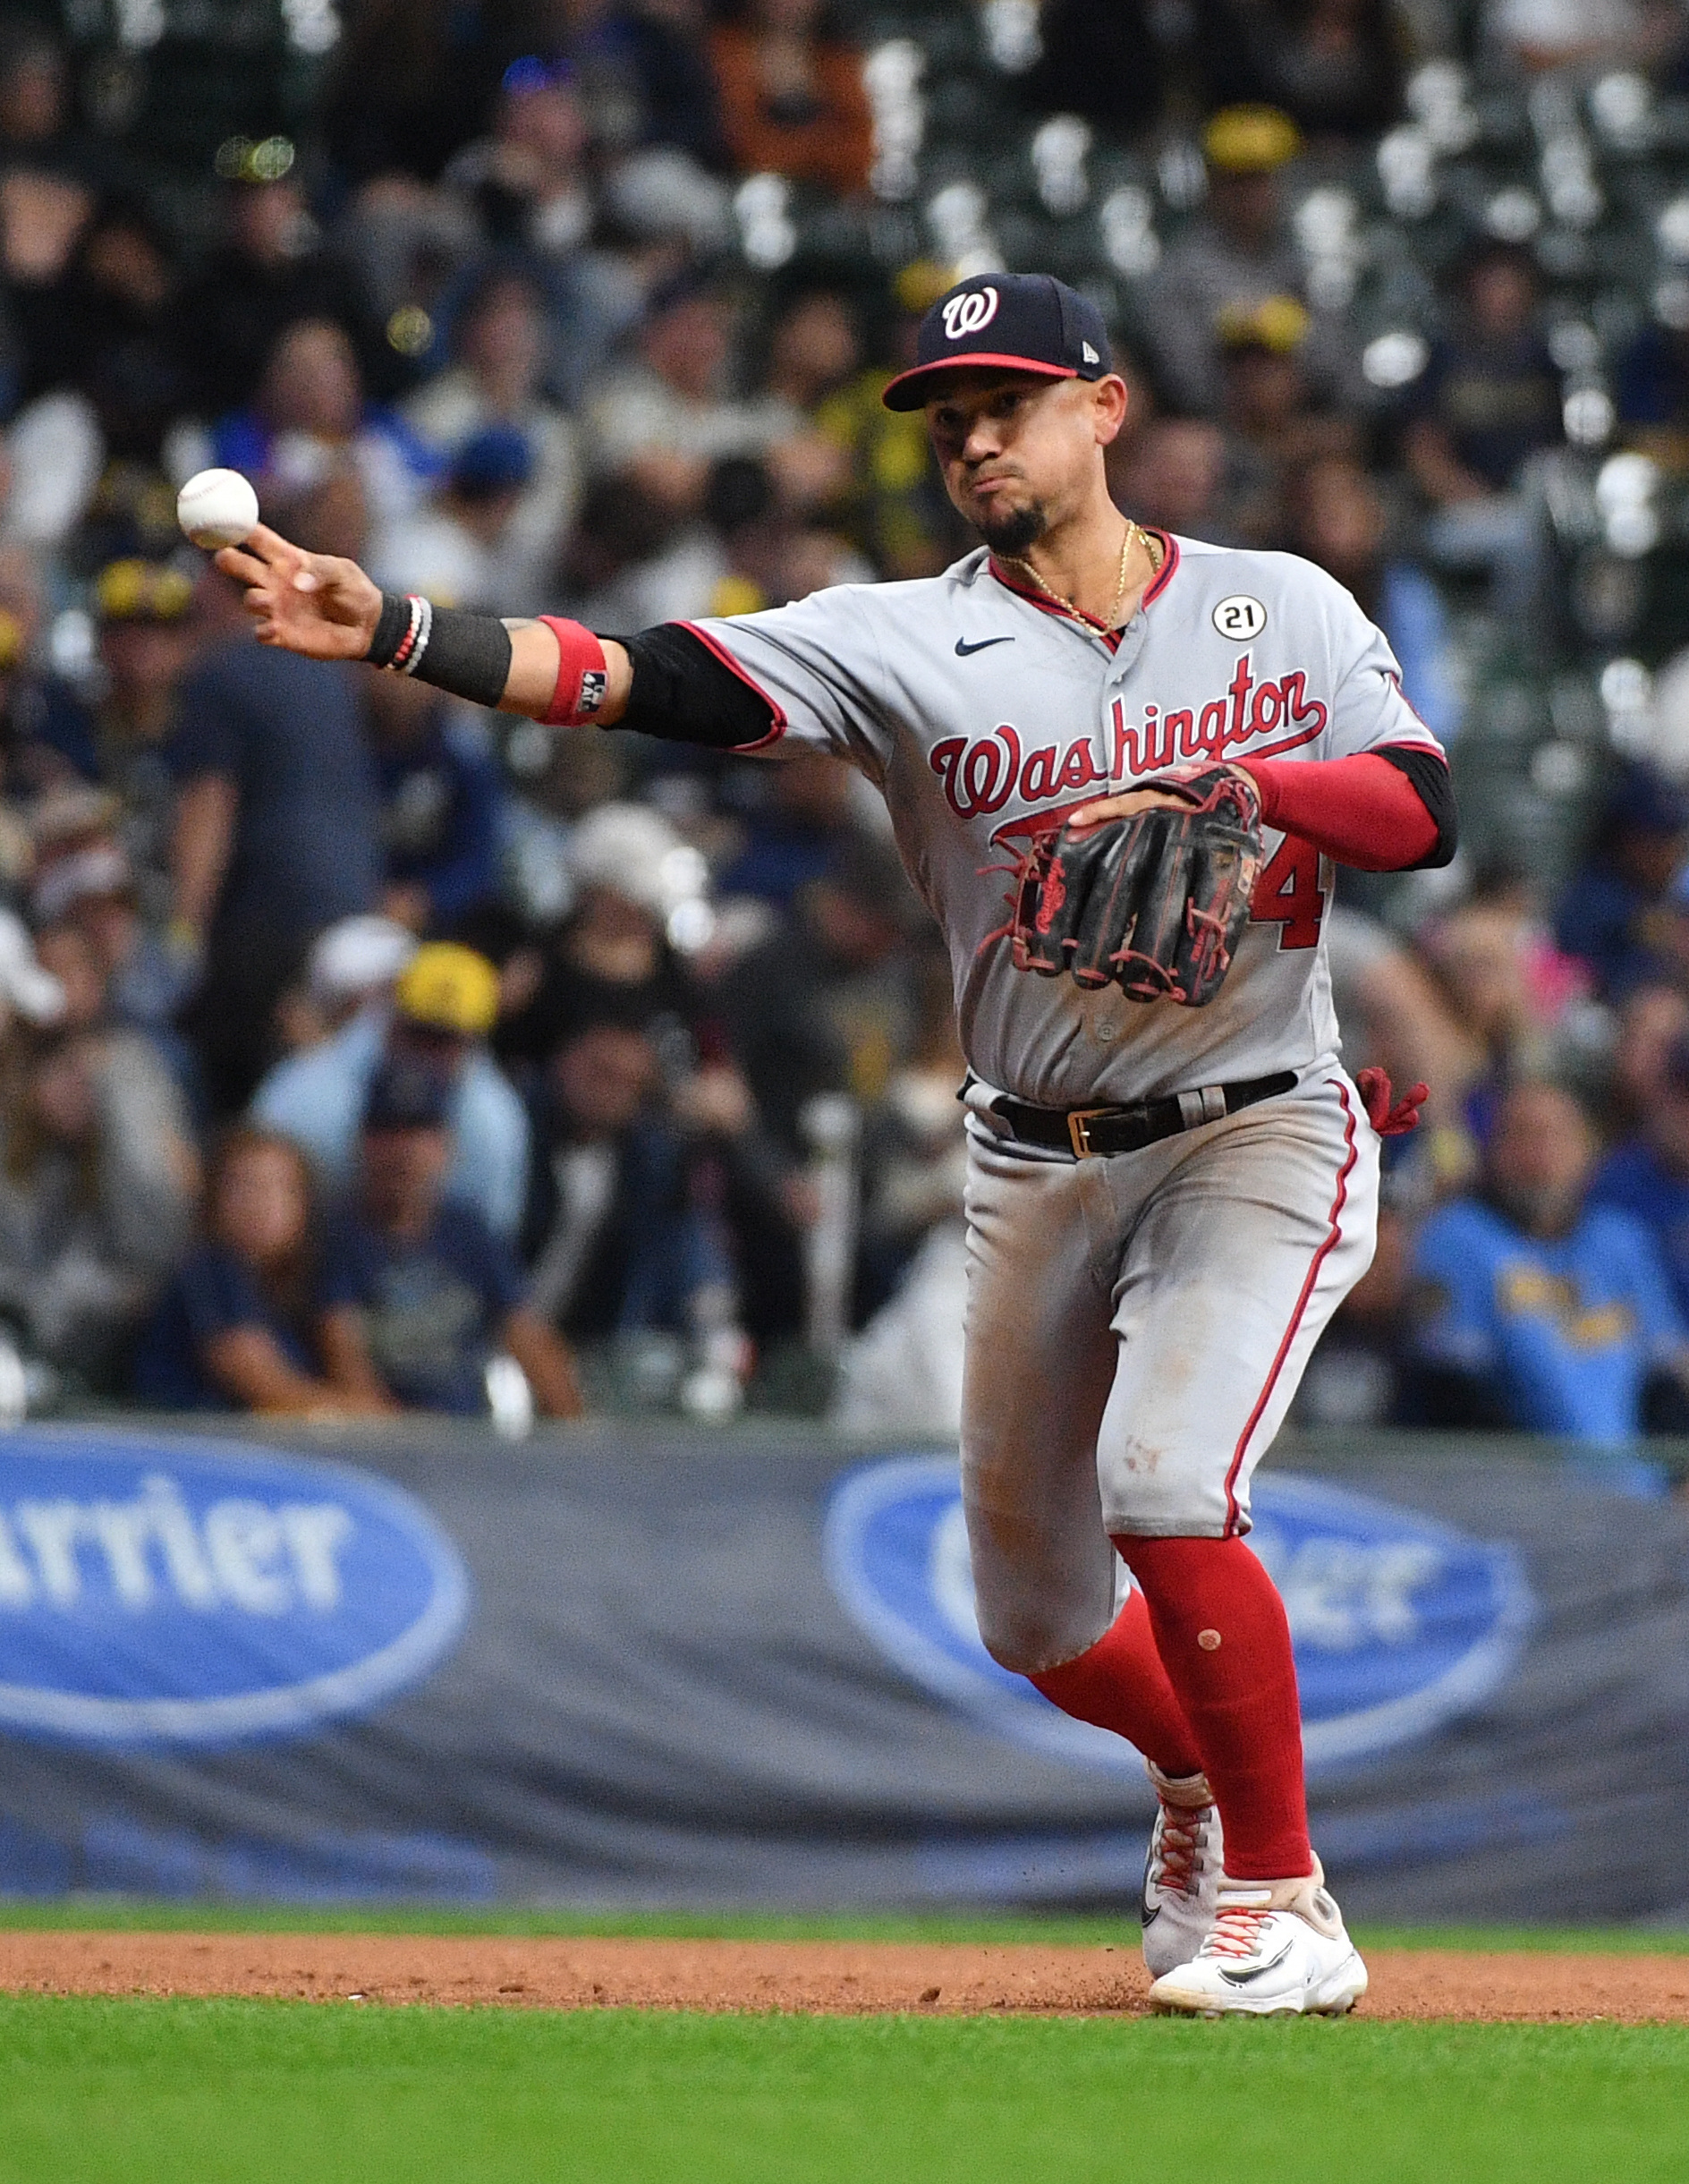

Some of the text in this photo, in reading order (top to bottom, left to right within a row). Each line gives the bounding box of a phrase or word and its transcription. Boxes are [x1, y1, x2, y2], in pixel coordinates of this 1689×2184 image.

[941, 286, 998, 339] W
[1224, 604, 1254, 628] 21
[927, 650, 1328, 821] Washington
